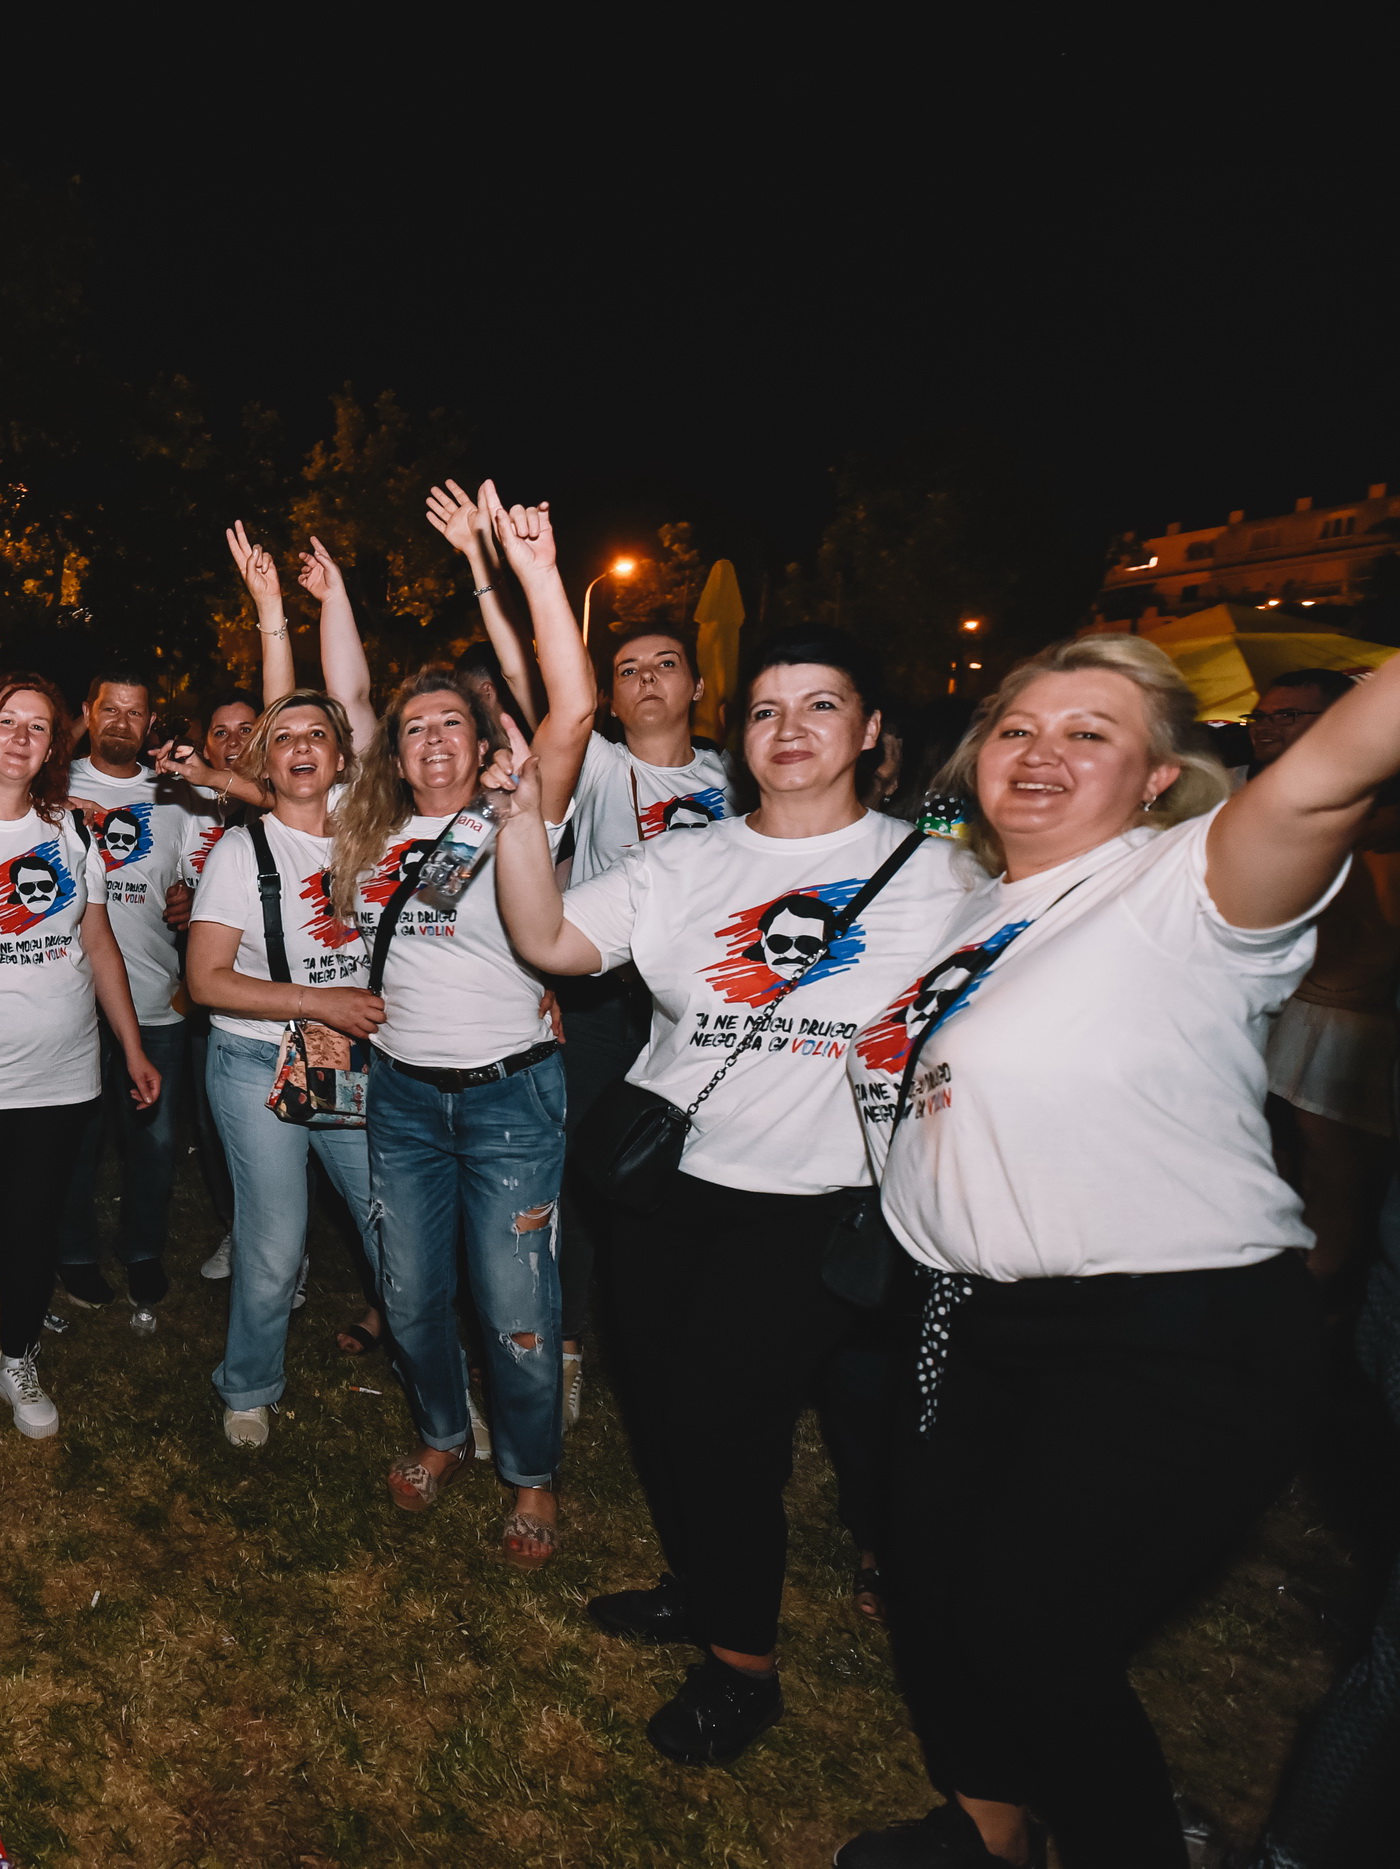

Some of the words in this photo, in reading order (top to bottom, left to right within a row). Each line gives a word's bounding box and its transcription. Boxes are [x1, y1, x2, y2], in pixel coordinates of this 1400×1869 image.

[106, 880, 124, 891] OGU
[125, 893, 146, 905] VOLIN
[360, 911, 375, 925] NE
[417, 908, 458, 924] DRUGO
[400, 925, 416, 937] GA
[419, 924, 456, 938] VOLIN
[0, 941, 15, 954] NE
[15, 937, 43, 953] MOGU
[44, 934, 73, 949] DRUGO
[19, 953, 32, 966] DA
[32, 952, 44, 965] GA
[44, 946, 69, 962] VOLIN
[302, 957, 317, 970] JA
[319, 954, 336, 969] NE
[308, 968, 337, 984] NEGO
[713, 1014, 740, 1031] NE
[797, 1017, 859, 1040] DRUGO
[689, 1030, 738, 1049] NEGO
[790, 1037, 848, 1060] VOLIN
[868, 1082, 892, 1101] NE
